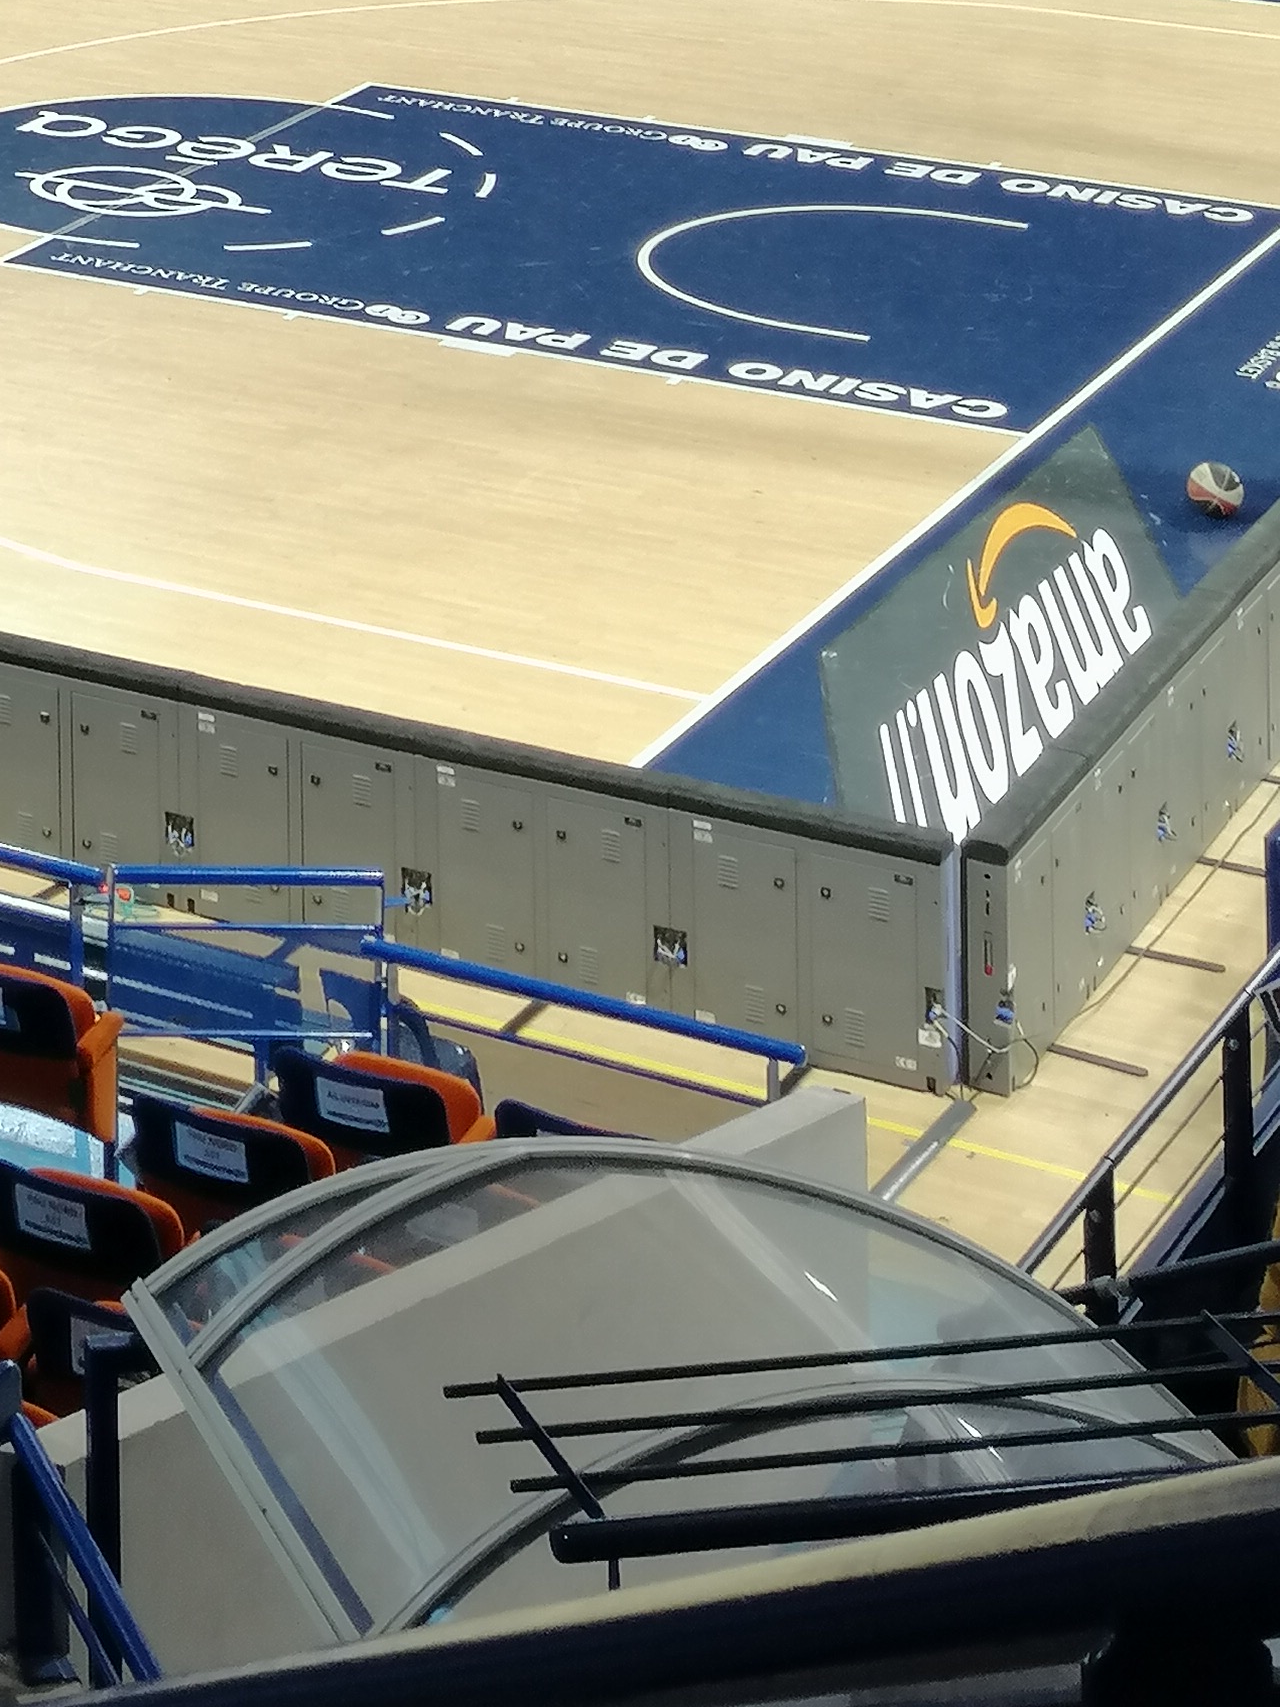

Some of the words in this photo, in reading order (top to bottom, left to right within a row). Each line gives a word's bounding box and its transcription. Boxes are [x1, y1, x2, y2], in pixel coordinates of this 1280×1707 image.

[377, 94, 545, 125] TRANCHANT
[550, 117, 667, 143] GROUPE
[743, 142, 874, 171] PAU
[885, 160, 982, 186] DE
[1000, 177, 1255, 223] CASINO
[50, 251, 231, 292] TRANCHANT
[237, 281, 365, 312] GROUPE
[444, 315, 592, 351] PAU
[599, 339, 710, 370] DE
[728, 360, 1008, 419] CASINO
